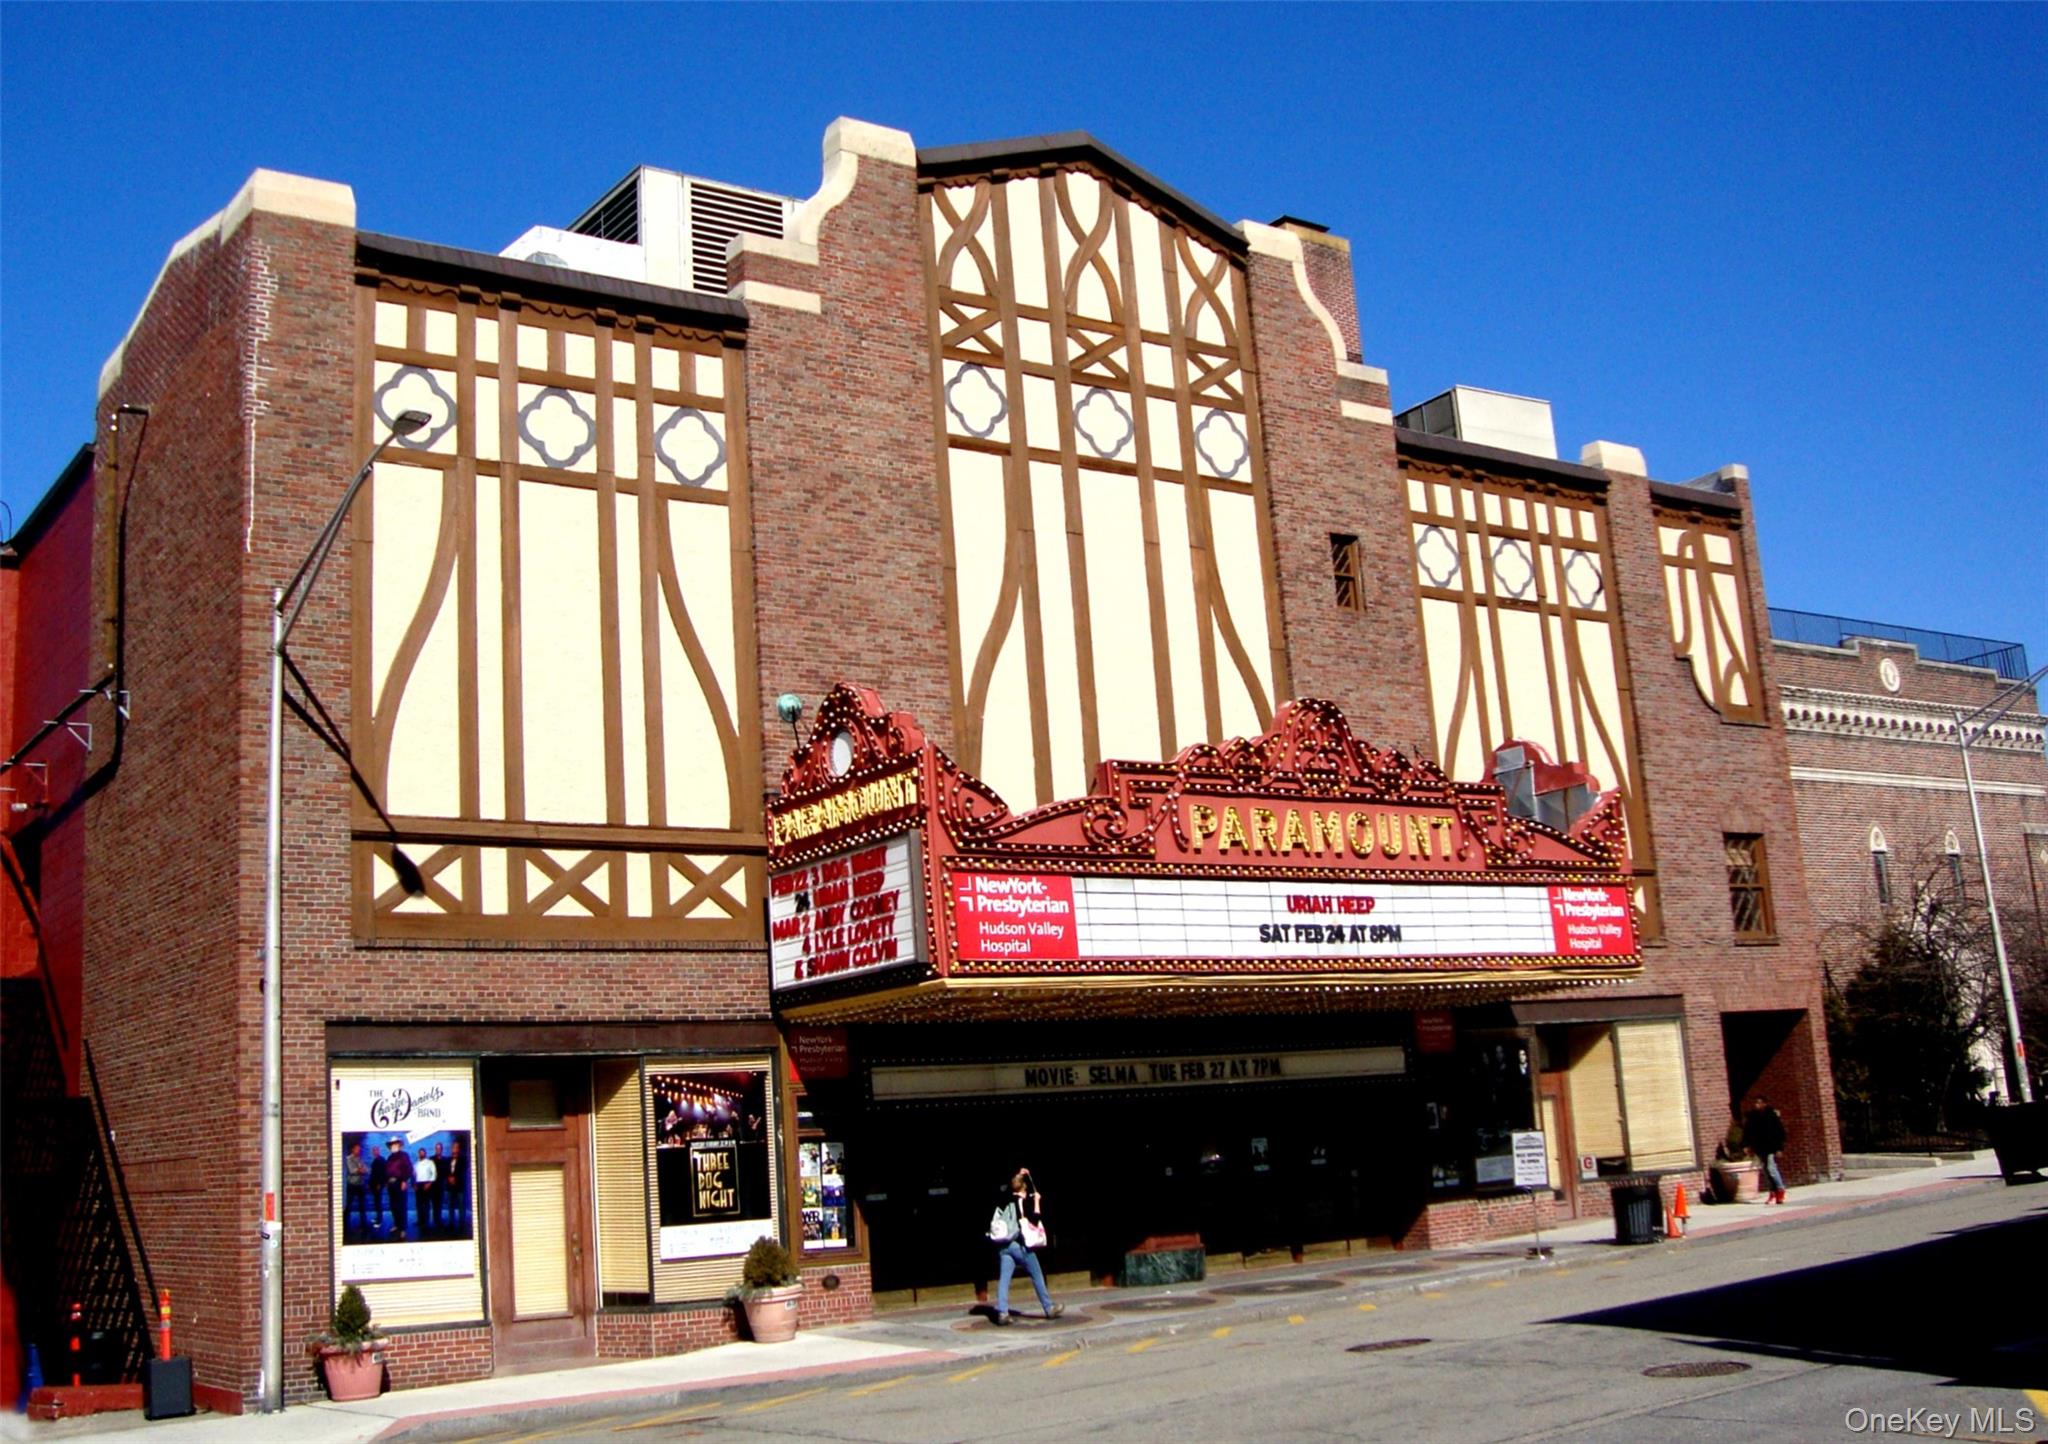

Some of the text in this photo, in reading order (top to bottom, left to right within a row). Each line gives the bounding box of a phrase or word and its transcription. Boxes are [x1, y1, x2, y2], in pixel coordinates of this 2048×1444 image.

[1189, 804, 1454, 859] PARAMOUNT
[821, 858, 849, 883] DOG
[975, 876, 1047, 894] NewYork-
[977, 895, 1069, 918] Presbyterian
[1286, 895, 1375, 914] URIAH HEEP
[1565, 903, 1624, 921] Presbyterian
[979, 921, 1064, 939] Hudson Valley
[1259, 924, 1402, 943] SAT FEB 24 AT 8PM
[1568, 924, 1598, 935] Hudson
[980, 938, 1031, 956] Hospital
[1570, 938, 1603, 951] Hospital
[1024, 1058, 1281, 1087] MOVIE: SELMA TUE FEB 27 AT 7PM
[369, 1089, 385, 1098] THE
[417, 1107, 441, 1118] BAND
[693, 1151, 730, 1172] THREE
[698, 1171, 722, 1190] DOG
[699, 1188, 735, 1209] NIGHT
